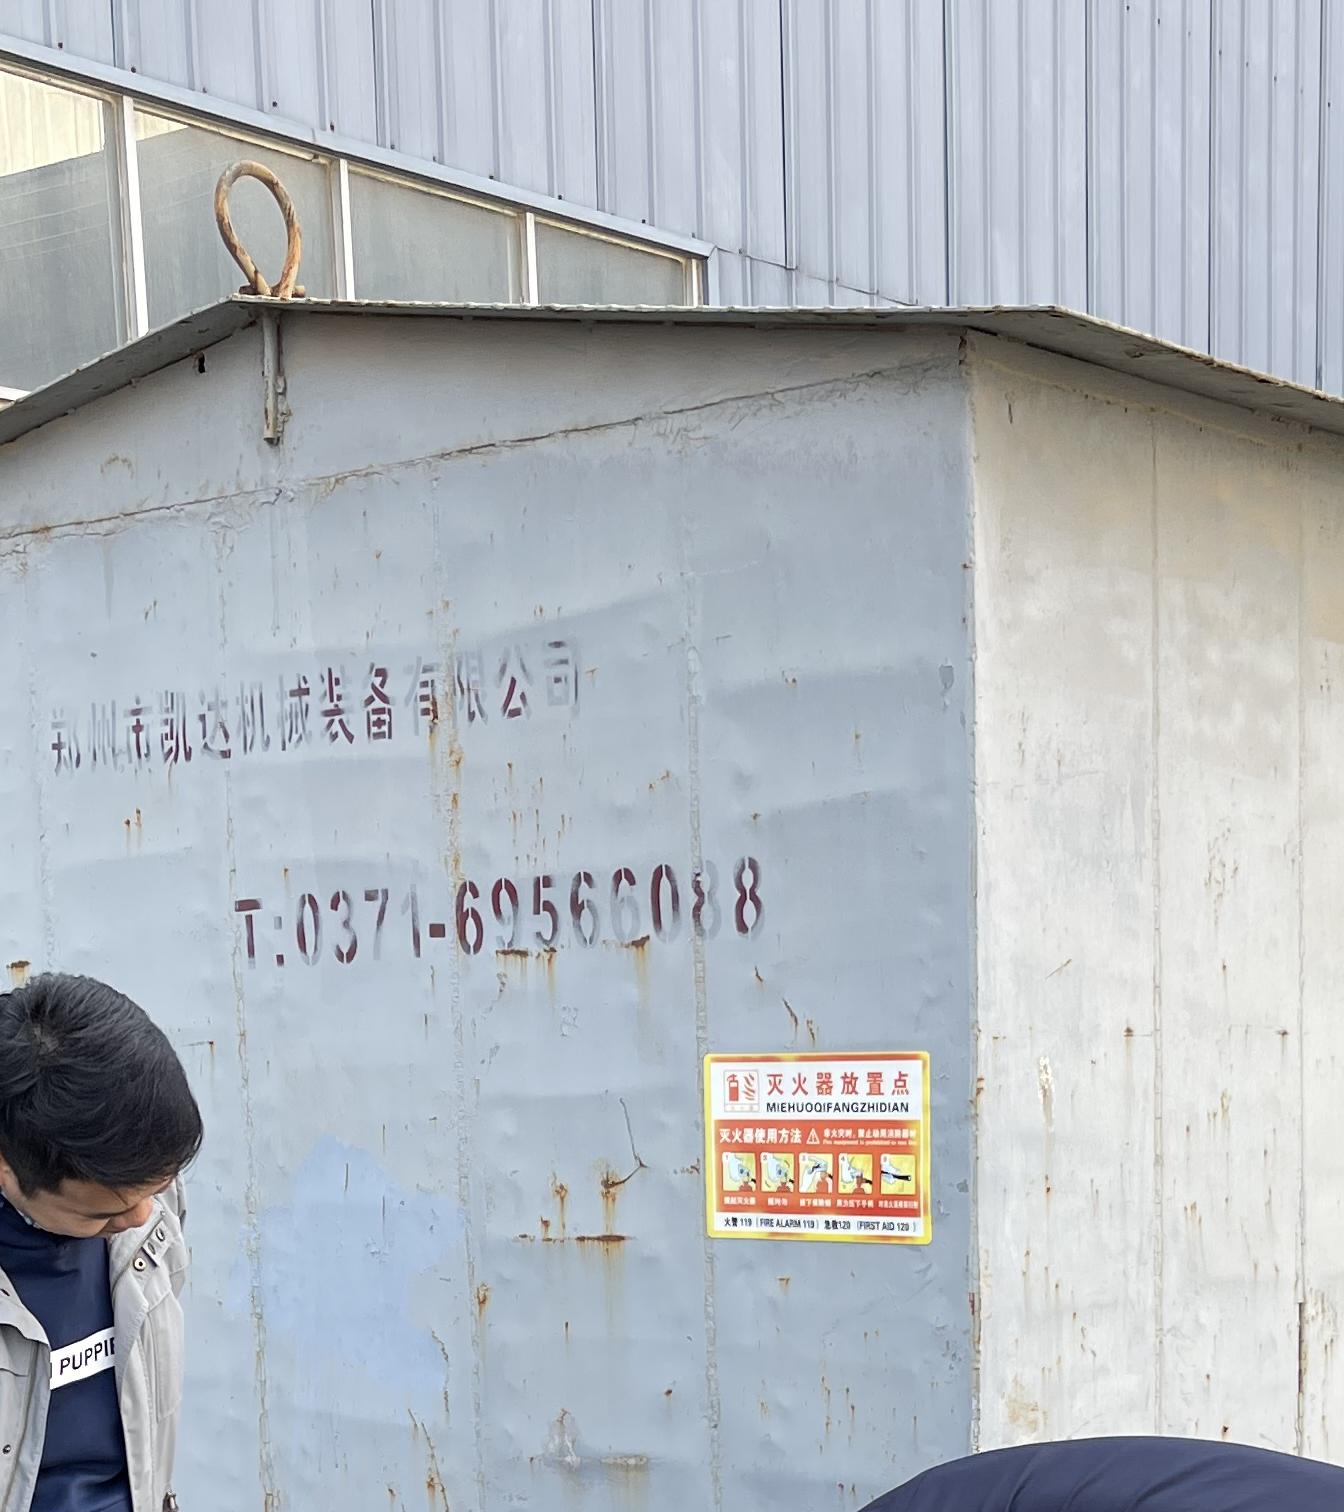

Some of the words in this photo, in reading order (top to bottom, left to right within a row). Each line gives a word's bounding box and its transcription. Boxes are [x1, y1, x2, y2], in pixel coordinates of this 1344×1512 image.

[51, 640, 581, 775] 郑州市凯达机械装备有限公司
[235, 856, 765, 968] T:0371-69566088
[766, 1071, 910, 1096] 灭火器放置点
[766, 1102, 909, 1113] MIEHUOQIFANGZHIDIAN
[719, 1127, 803, 1145] 灭火器使用方法
[740, 1217, 752, 1227] 119
[776, 1218, 801, 1228] ALARM
[882, 1221, 895, 1231] AID
